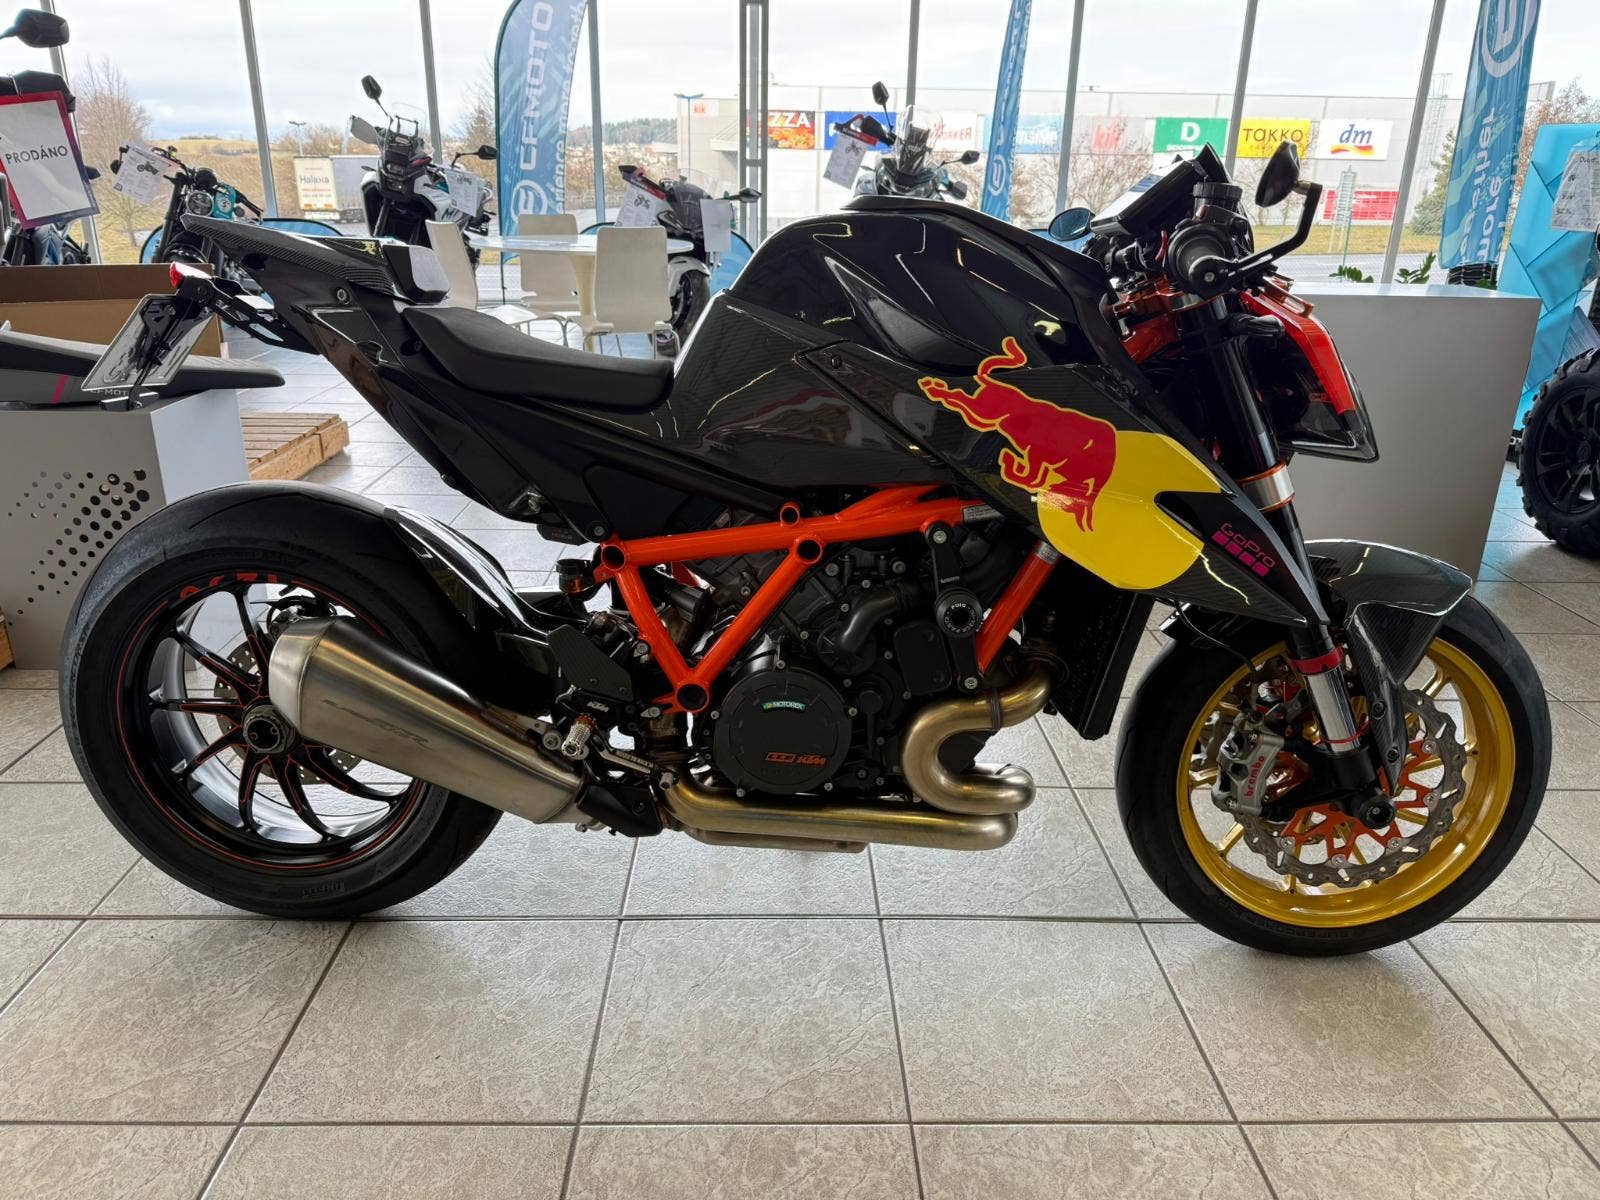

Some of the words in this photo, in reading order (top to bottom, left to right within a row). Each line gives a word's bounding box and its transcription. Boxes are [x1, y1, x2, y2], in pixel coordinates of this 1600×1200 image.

[519, 2, 554, 170] CFMOTO
[768, 112, 811, 128] ZZA
[1180, 121, 1201, 142] D
[1339, 124, 1373, 144] dm
[5, 145, 68, 164] PRODÁNO
[1220, 523, 1276, 568] GoPro
[587, 701, 610, 713] KTM
[772, 701, 806, 710] MOTOREX
[1244, 755, 1265, 797] brembo
